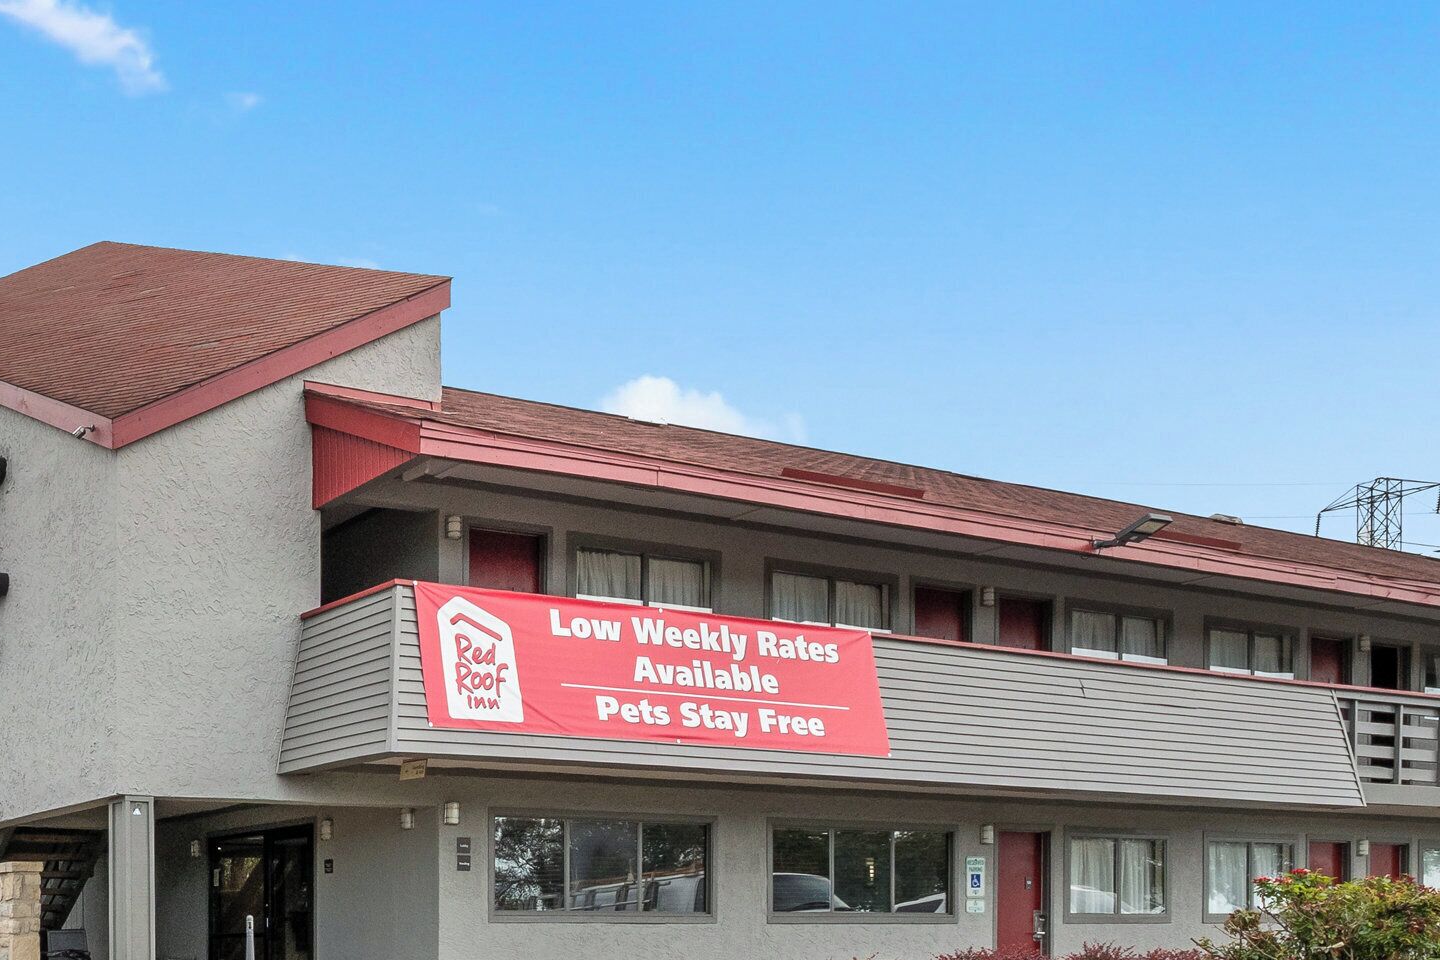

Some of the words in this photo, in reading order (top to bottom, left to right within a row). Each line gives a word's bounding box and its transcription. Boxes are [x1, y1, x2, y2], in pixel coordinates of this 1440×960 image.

[455, 634, 497, 665] Red
[549, 609, 621, 642] Low
[631, 617, 748, 661] Weekly
[757, 631, 840, 664] Rates
[454, 661, 509, 700] Roof
[633, 656, 780, 695] Available
[595, 695, 670, 727] Pets
[681, 702, 750, 739] Stay
[759, 708, 825, 737] Free
